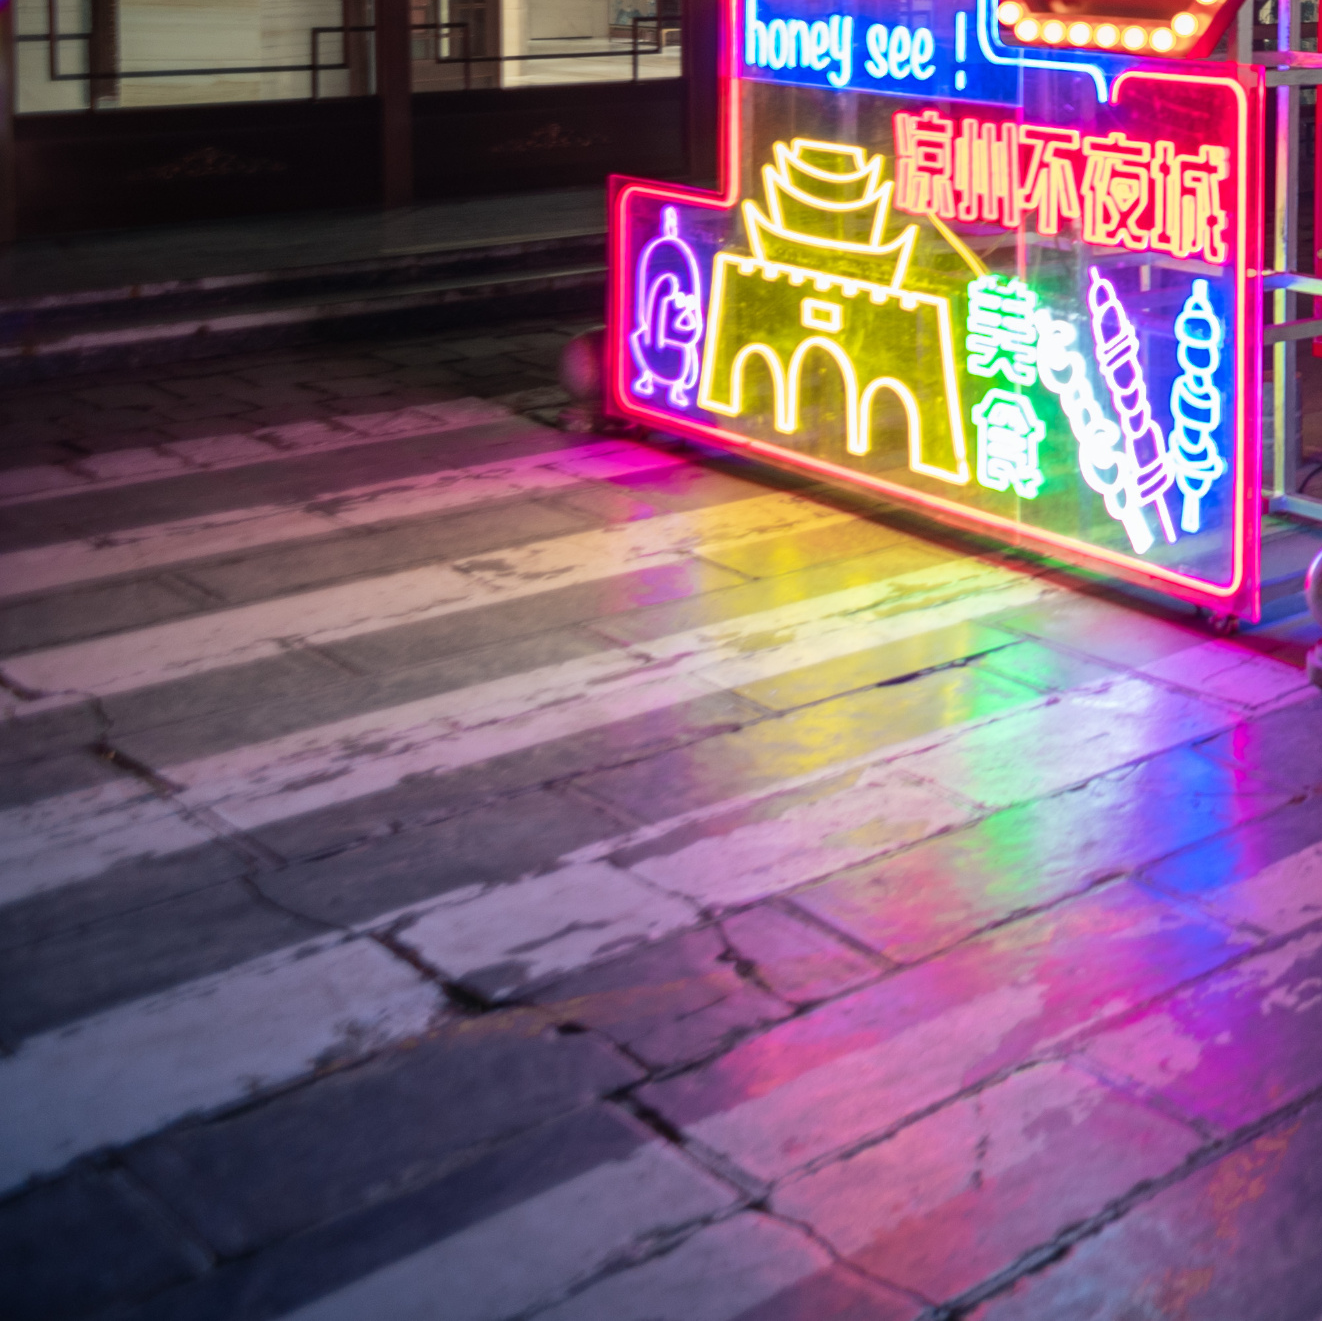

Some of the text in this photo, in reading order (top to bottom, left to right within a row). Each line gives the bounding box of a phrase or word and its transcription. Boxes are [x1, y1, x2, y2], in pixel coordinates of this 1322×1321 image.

[894, 110, 1229, 263] 凉州不夜城
[967, 273, 1046, 498] 美食
